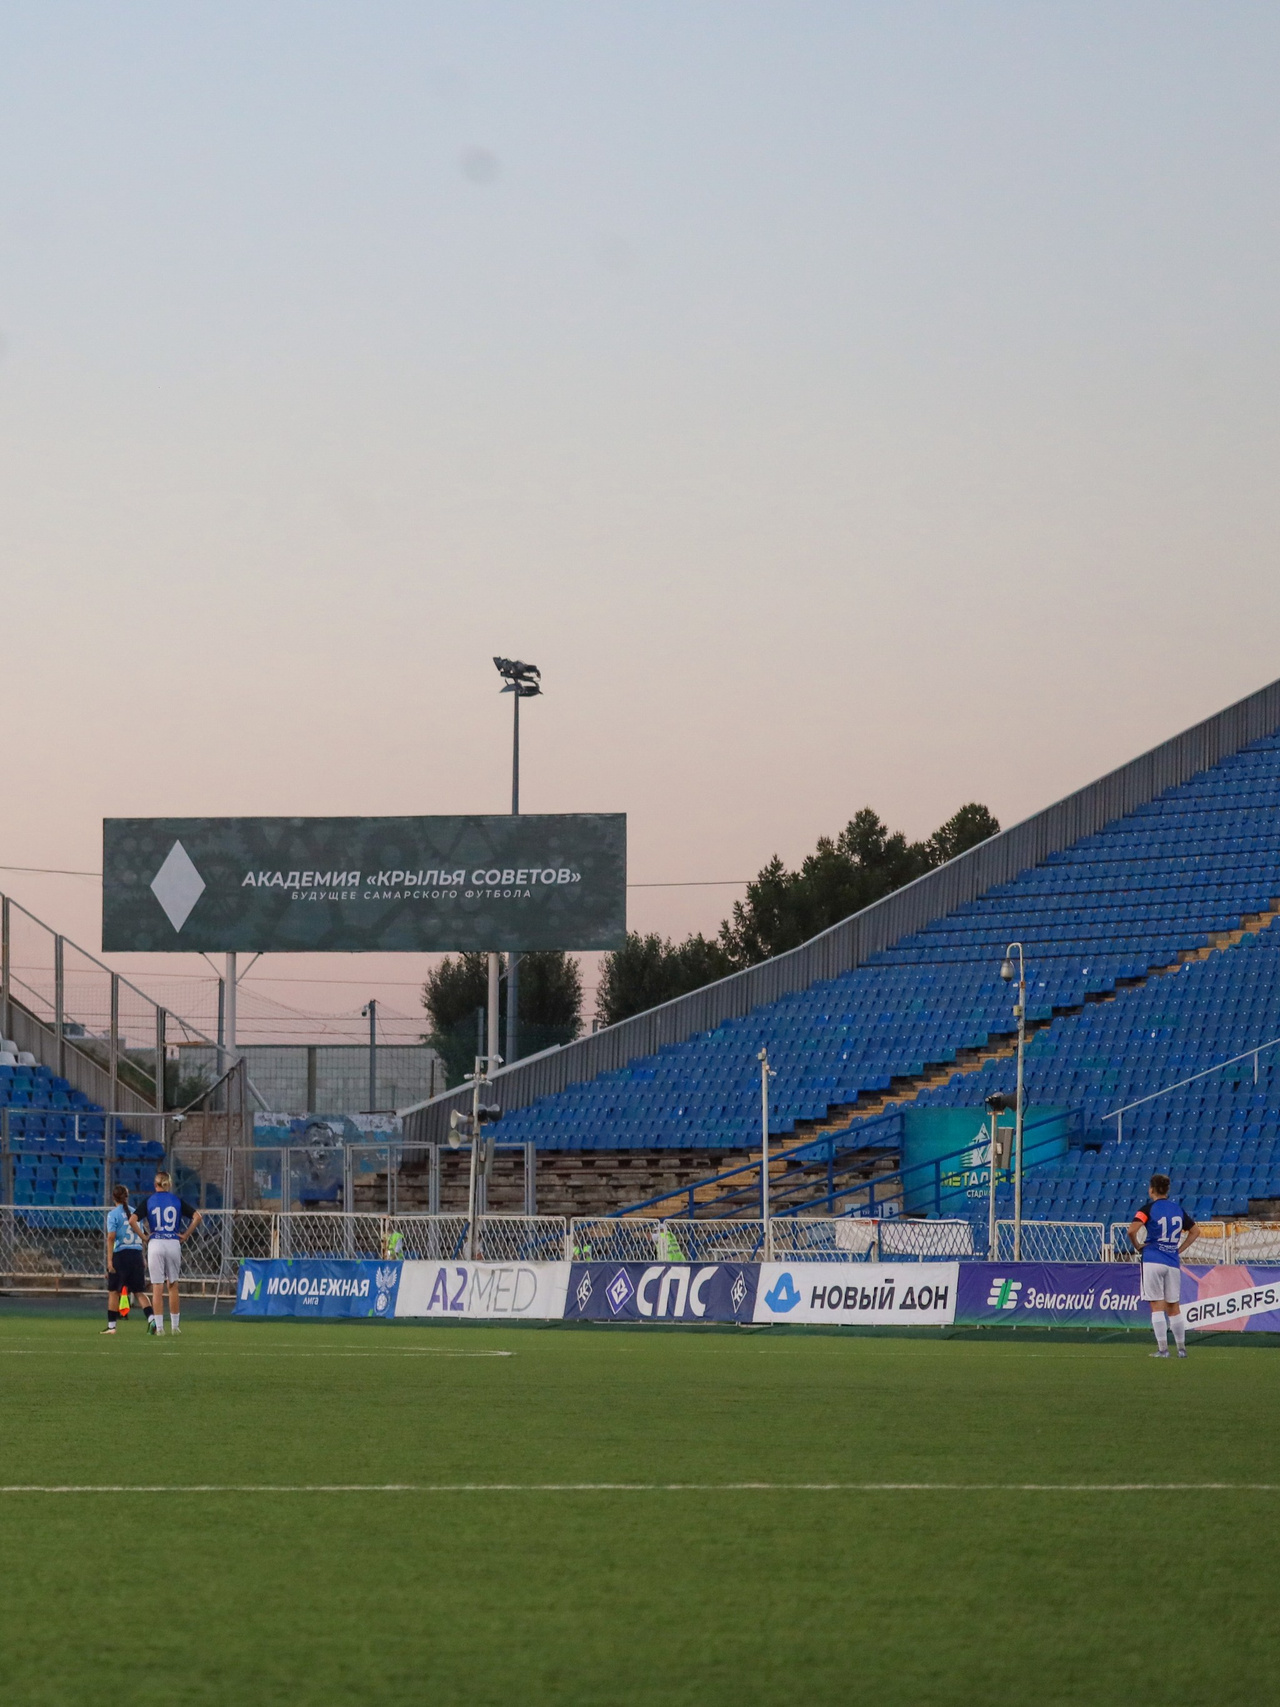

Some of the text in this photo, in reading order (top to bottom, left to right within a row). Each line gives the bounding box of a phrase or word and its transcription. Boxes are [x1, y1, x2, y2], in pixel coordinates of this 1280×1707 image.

[241, 868, 581, 890] АКАДЕМИЯ «КРЫЛЬЯ СОВЕТОВ»
[291, 889, 532, 901] БУДУЩЕЕ САМАРСКОГО ФУТБОЛА
[151, 1206, 177, 1232] 19
[1157, 1216, 1183, 1243] 12
[266, 1277, 370, 1297] МОЛОДЕЖНАЯ
[636, 1266, 719, 1317] СПС
[810, 1279, 949, 1311] НОВЫЙ ДОН
[1024, 1287, 1141, 1311] Земский банк
